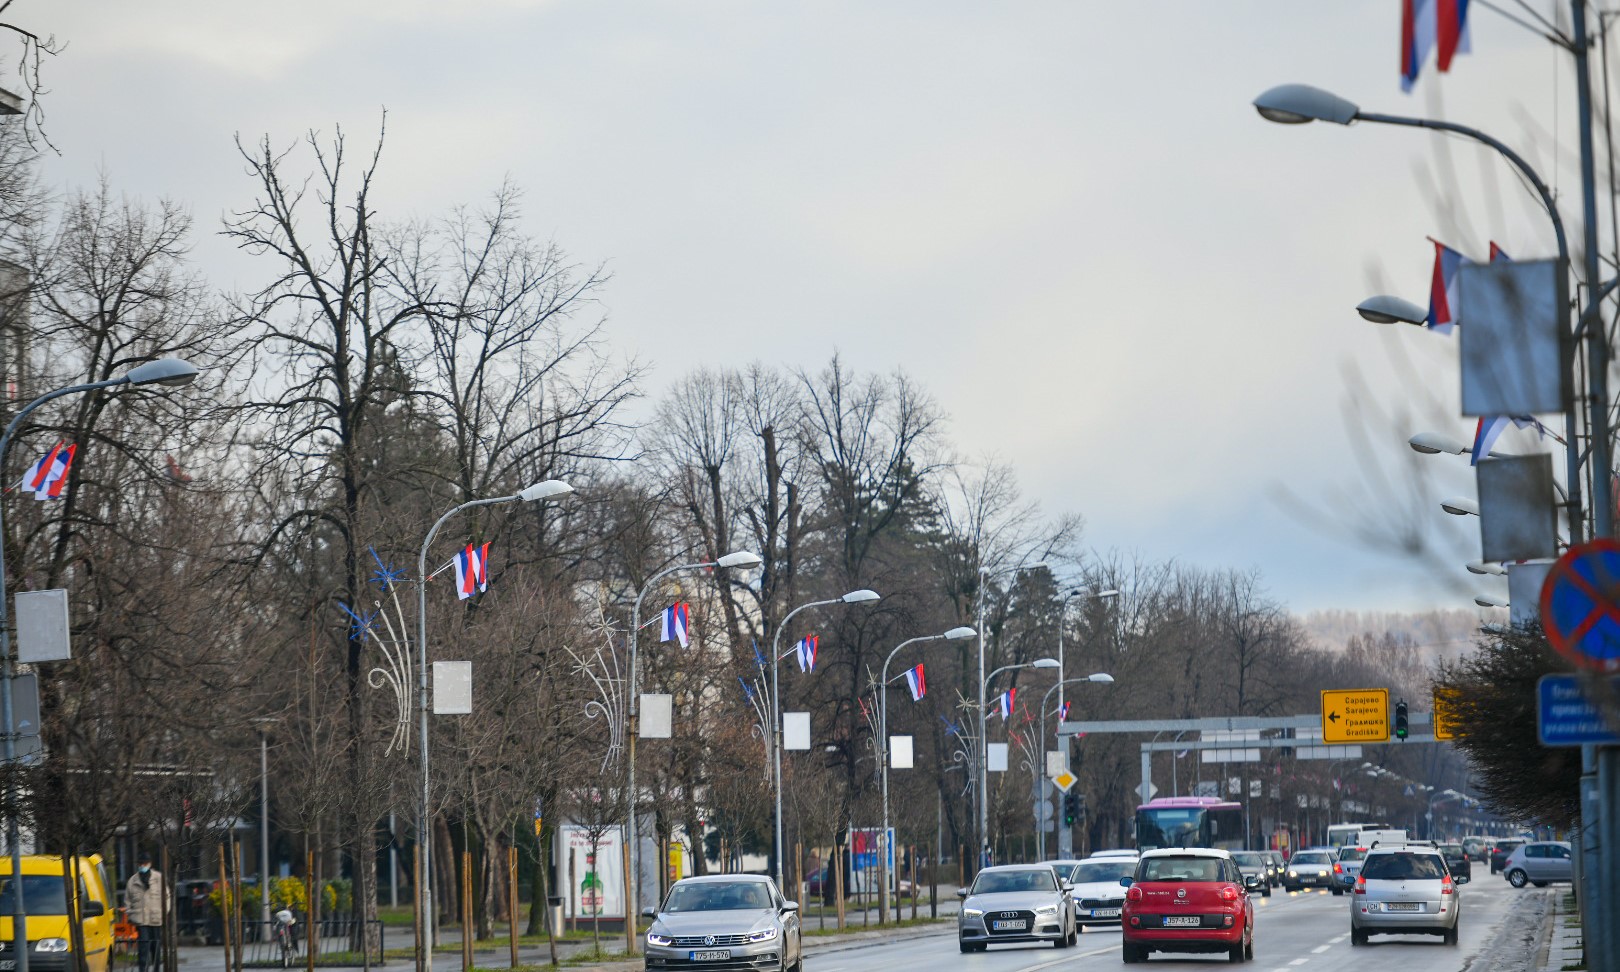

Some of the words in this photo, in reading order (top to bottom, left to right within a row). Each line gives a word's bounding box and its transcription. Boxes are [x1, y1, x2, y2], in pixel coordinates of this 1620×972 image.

[1345, 697, 1379, 705] Сарајево
[1345, 707, 1379, 715] Sarajevo
[1345, 719, 1384, 727] Градишка
[1346, 728, 1379, 736] Gradiška
[695, 951, 729, 960] T75-M-576
